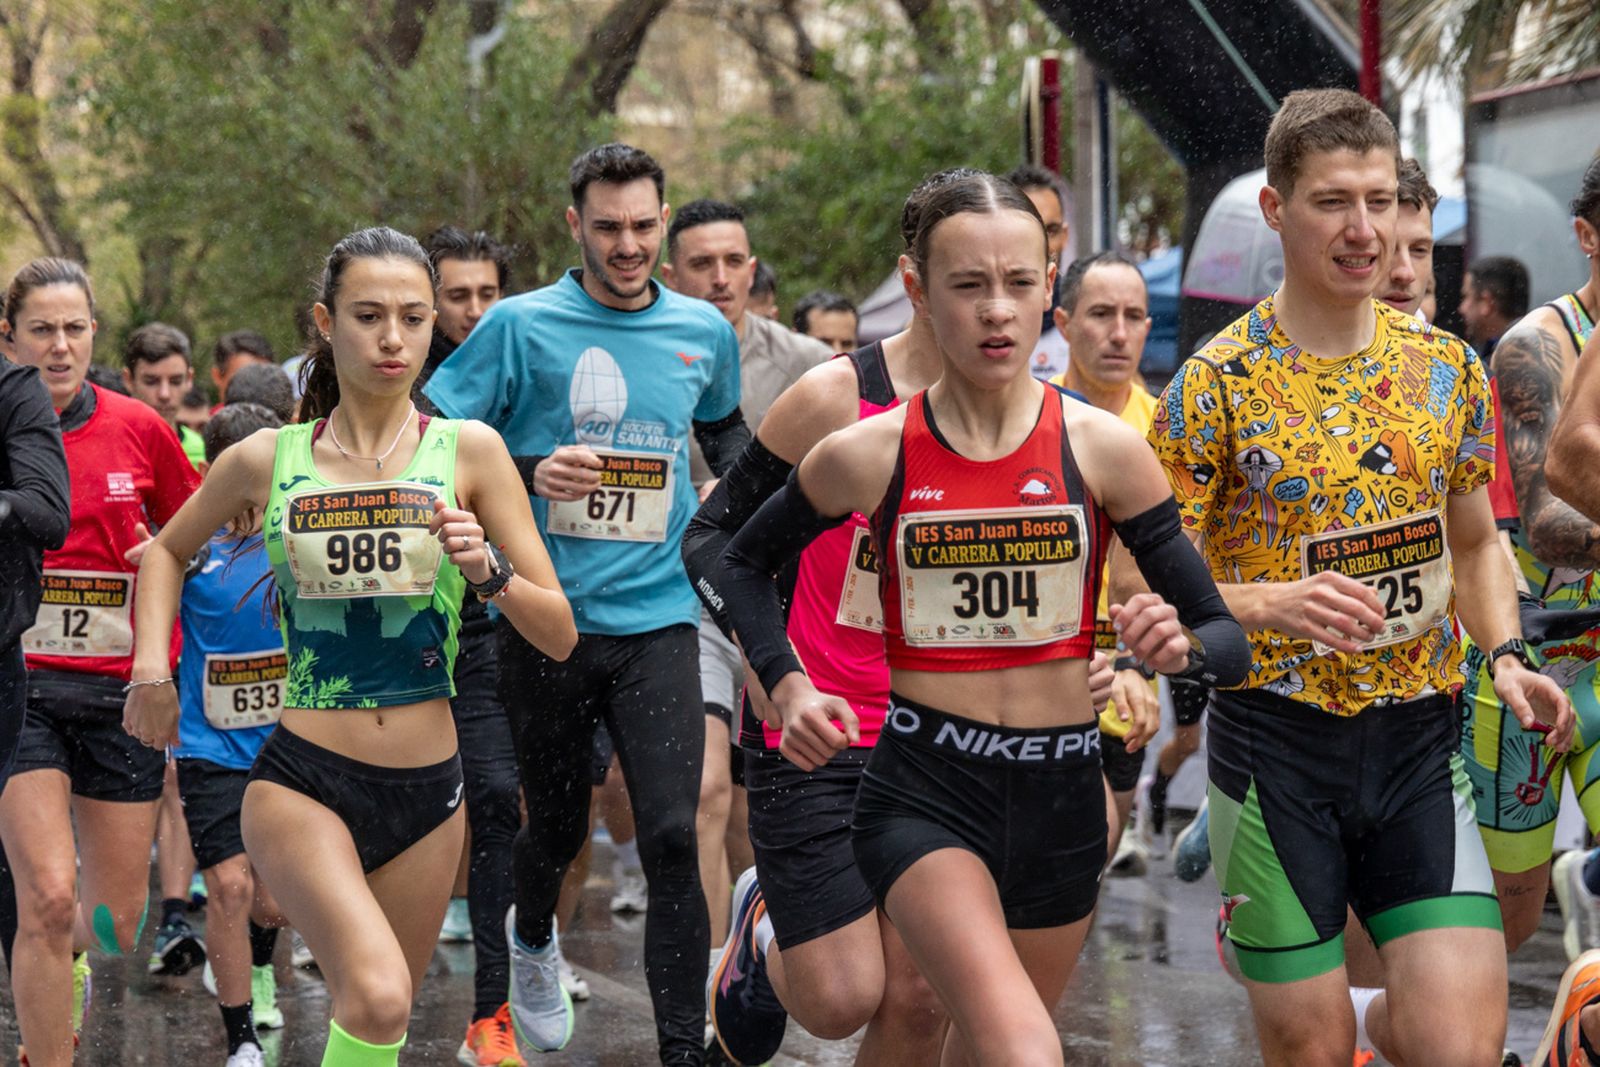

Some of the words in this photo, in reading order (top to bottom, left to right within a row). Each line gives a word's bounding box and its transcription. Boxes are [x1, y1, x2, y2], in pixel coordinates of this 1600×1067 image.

[580, 420, 610, 436] 40
[607, 457, 631, 470] Juan
[633, 459, 662, 472] Bosco
[621, 472, 663, 487] POPULAR
[299, 498, 320, 512] IES
[324, 496, 349, 511] San
[353, 493, 385, 508] Juan
[389, 490, 429, 506] Bosco
[586, 489, 636, 523] 671
[295, 514, 304, 529] V
[308, 511, 369, 529] CARRERA
[373, 508, 434, 526] POPULAR
[915, 525, 940, 544] IES
[943, 524, 975, 542] San
[979, 523, 1017, 540] Juan
[1022, 520, 1068, 538] Bosco
[1316, 542, 1338, 560] IES
[1342, 539, 1369, 555] San
[1372, 531, 1402, 550] Juan
[1403, 521, 1438, 540] Bosco
[326, 531, 402, 576] 986
[862, 553, 872, 568] V
[911, 547, 923, 565] V
[927, 544, 1000, 565] CARRERA
[1004, 540, 1074, 562] POPULAR
[1330, 552, 1390, 577] CARRERA
[1392, 538, 1441, 566] POPULAR
[47, 577, 67, 589] San
[70, 578, 93, 590] Juan
[95, 578, 123, 591] Bosco
[696, 576, 725, 612] KIPRUN
[951, 570, 1040, 620] 304
[1361, 569, 1424, 620] 25
[41, 589, 81, 604] ARRERA
[83, 591, 124, 605] POPULAR
[62, 608, 90, 639] 12
[219, 670, 260, 685] CARRERA
[233, 683, 280, 713] 633
[934, 721, 1051, 761] NIKE
